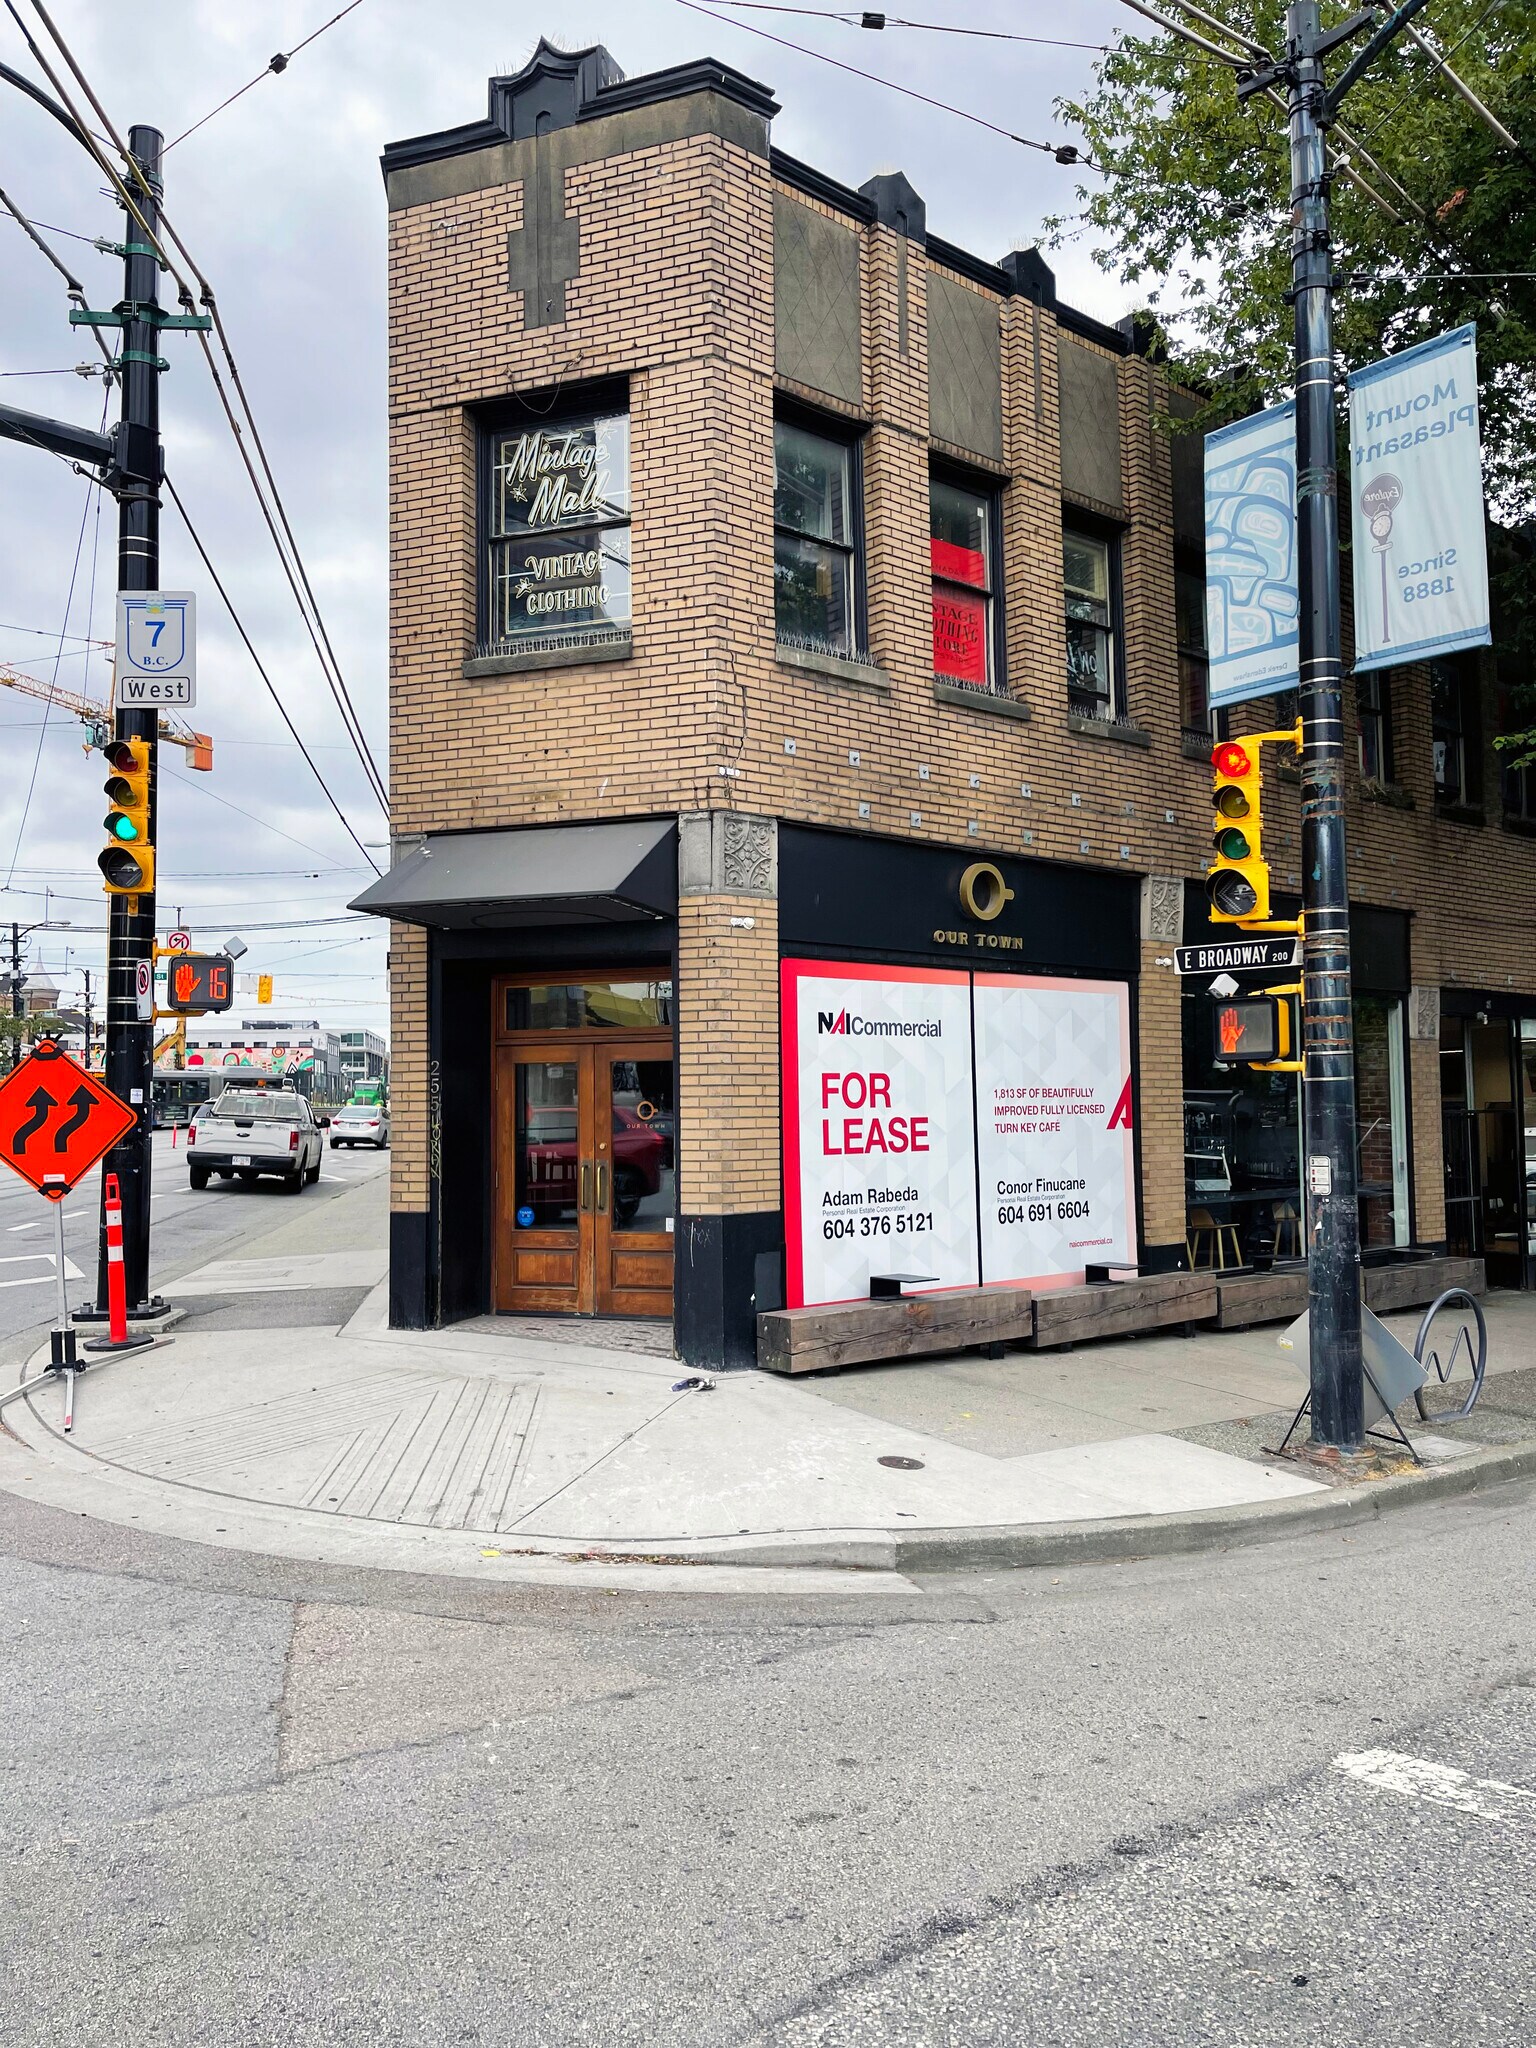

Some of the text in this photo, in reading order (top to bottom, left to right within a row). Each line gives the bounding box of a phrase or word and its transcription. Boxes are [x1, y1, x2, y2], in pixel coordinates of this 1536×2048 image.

[506, 431, 610, 486] Mintage
[527, 469, 611, 528] Mall
[525, 550, 608, 581] VINTAGE
[526, 584, 610, 616] CLOTHING
[145, 621, 166, 648] 7
[933, 636, 969, 655] TORE
[143, 656, 168, 666] B.C.
[128, 682, 184, 698] West
[933, 930, 1023, 950] OUR TOWN
[1184, 945, 1288, 969] E BROADWAY 200
[210, 967, 227, 999] 16
[821, 1072, 892, 1109] FOR
[994, 1088, 1094, 1100] 1,813 SF OF BEAUTIFULLY
[994, 1104, 1105, 1116] IMPROVED FULLY LICENSED
[822, 1117, 930, 1155] LEASE
[995, 1119, 1061, 1133] TURN KEY CAFÉ
[822, 1186, 919, 1207] Adam Rabeda
[997, 1178, 1086, 1195] Conor Finucane
[822, 1204, 906, 1217] Personal Real Estate Corporation
[998, 1200, 1090, 1225] 604 691 6604
[823, 1212, 933, 1240] 604 376 5121
[1069, 1237, 1113, 1248] naicommercial.ca
